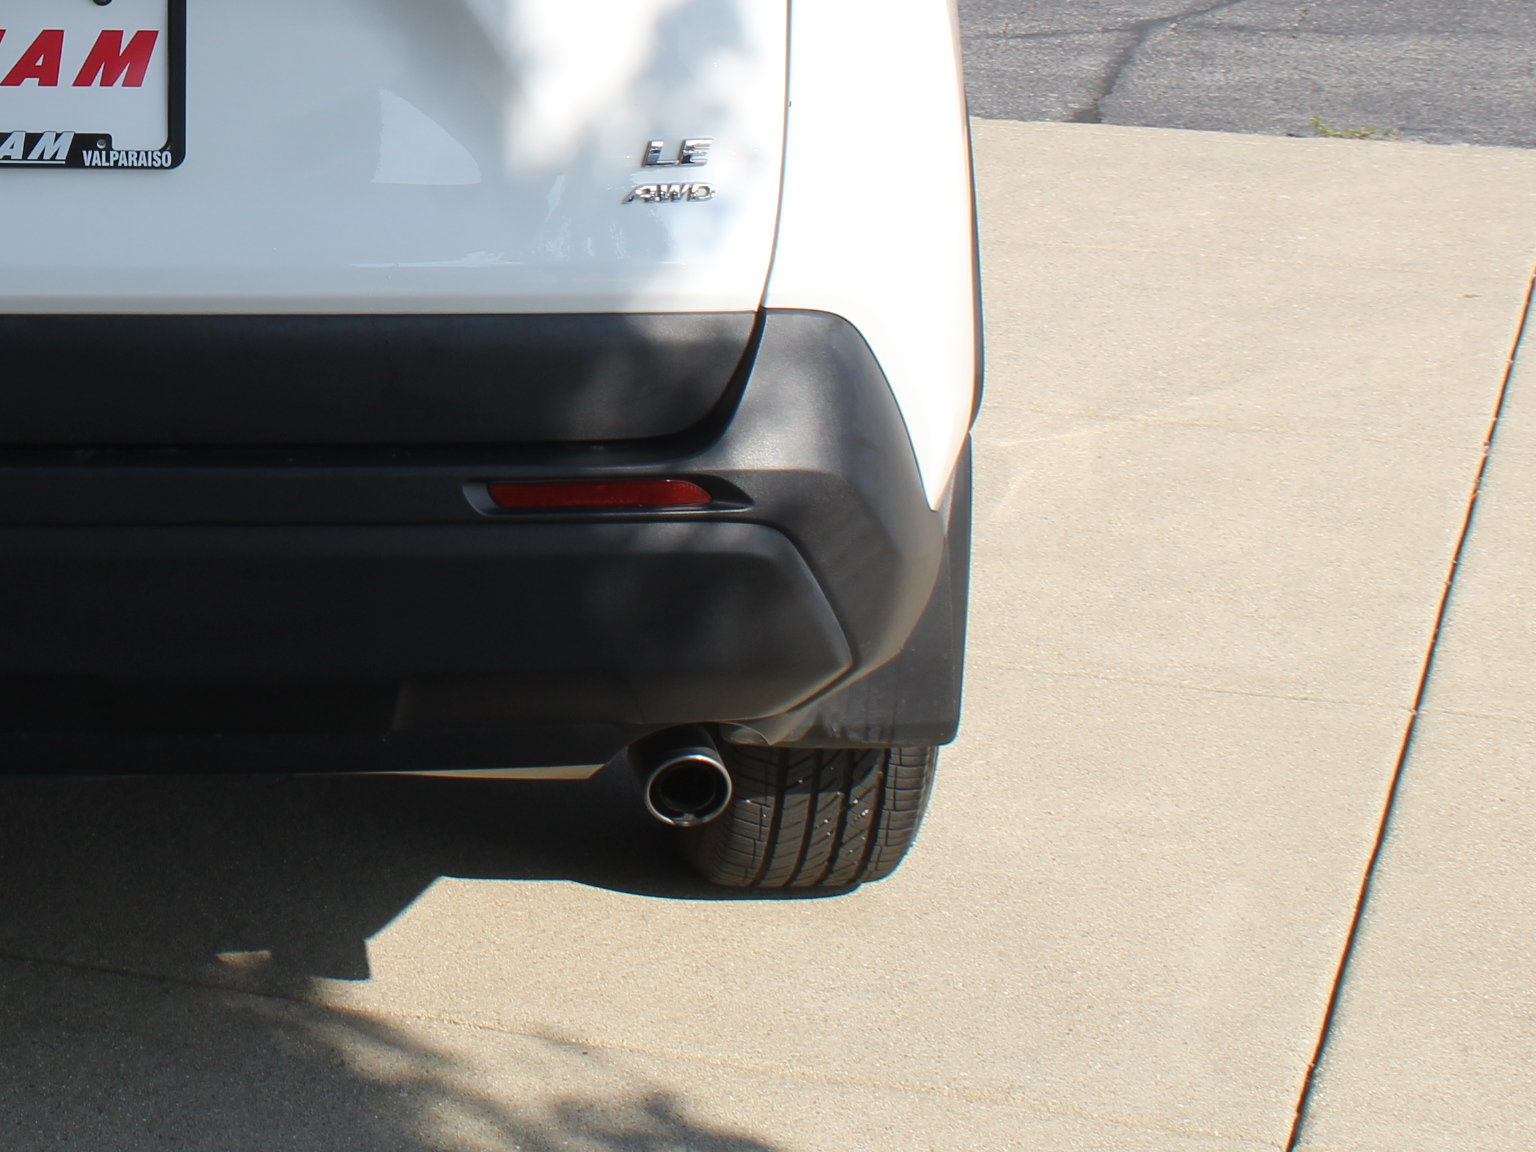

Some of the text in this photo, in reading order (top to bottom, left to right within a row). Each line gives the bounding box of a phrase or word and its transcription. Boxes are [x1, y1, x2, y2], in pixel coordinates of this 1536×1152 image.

[82, 149, 172, 168] VALPARAISO
[641, 138, 713, 168] LE
[621, 182, 718, 204] AWD
